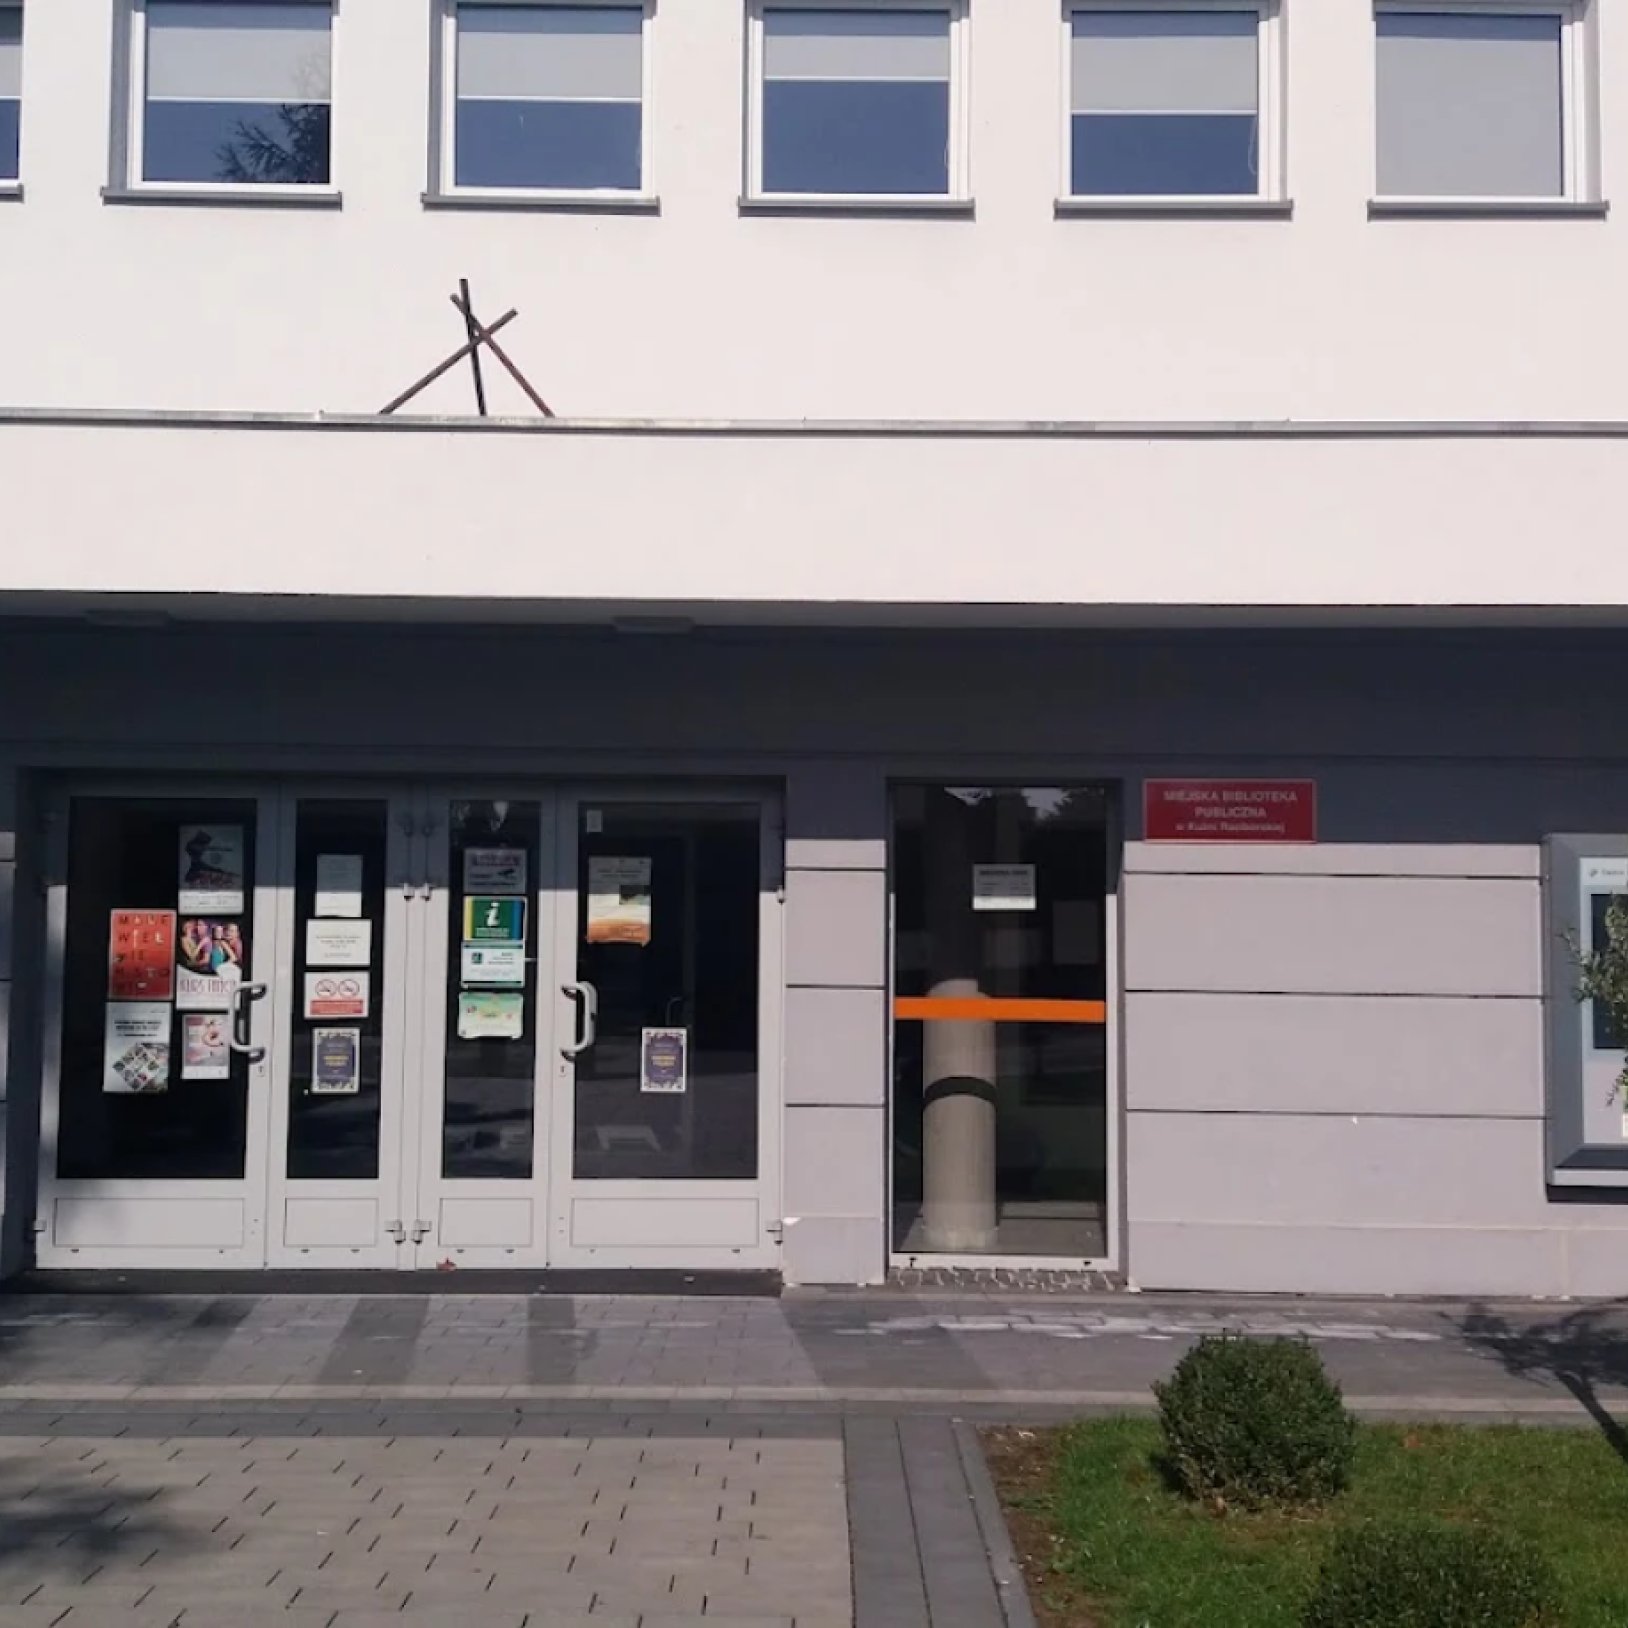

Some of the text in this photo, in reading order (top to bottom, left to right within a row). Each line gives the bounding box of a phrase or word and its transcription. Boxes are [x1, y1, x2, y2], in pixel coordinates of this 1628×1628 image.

[1163, 790, 1298, 801] MIEJSKA BIBLIOTEKA
[1194, 806, 1267, 818] PUBLICZNA
